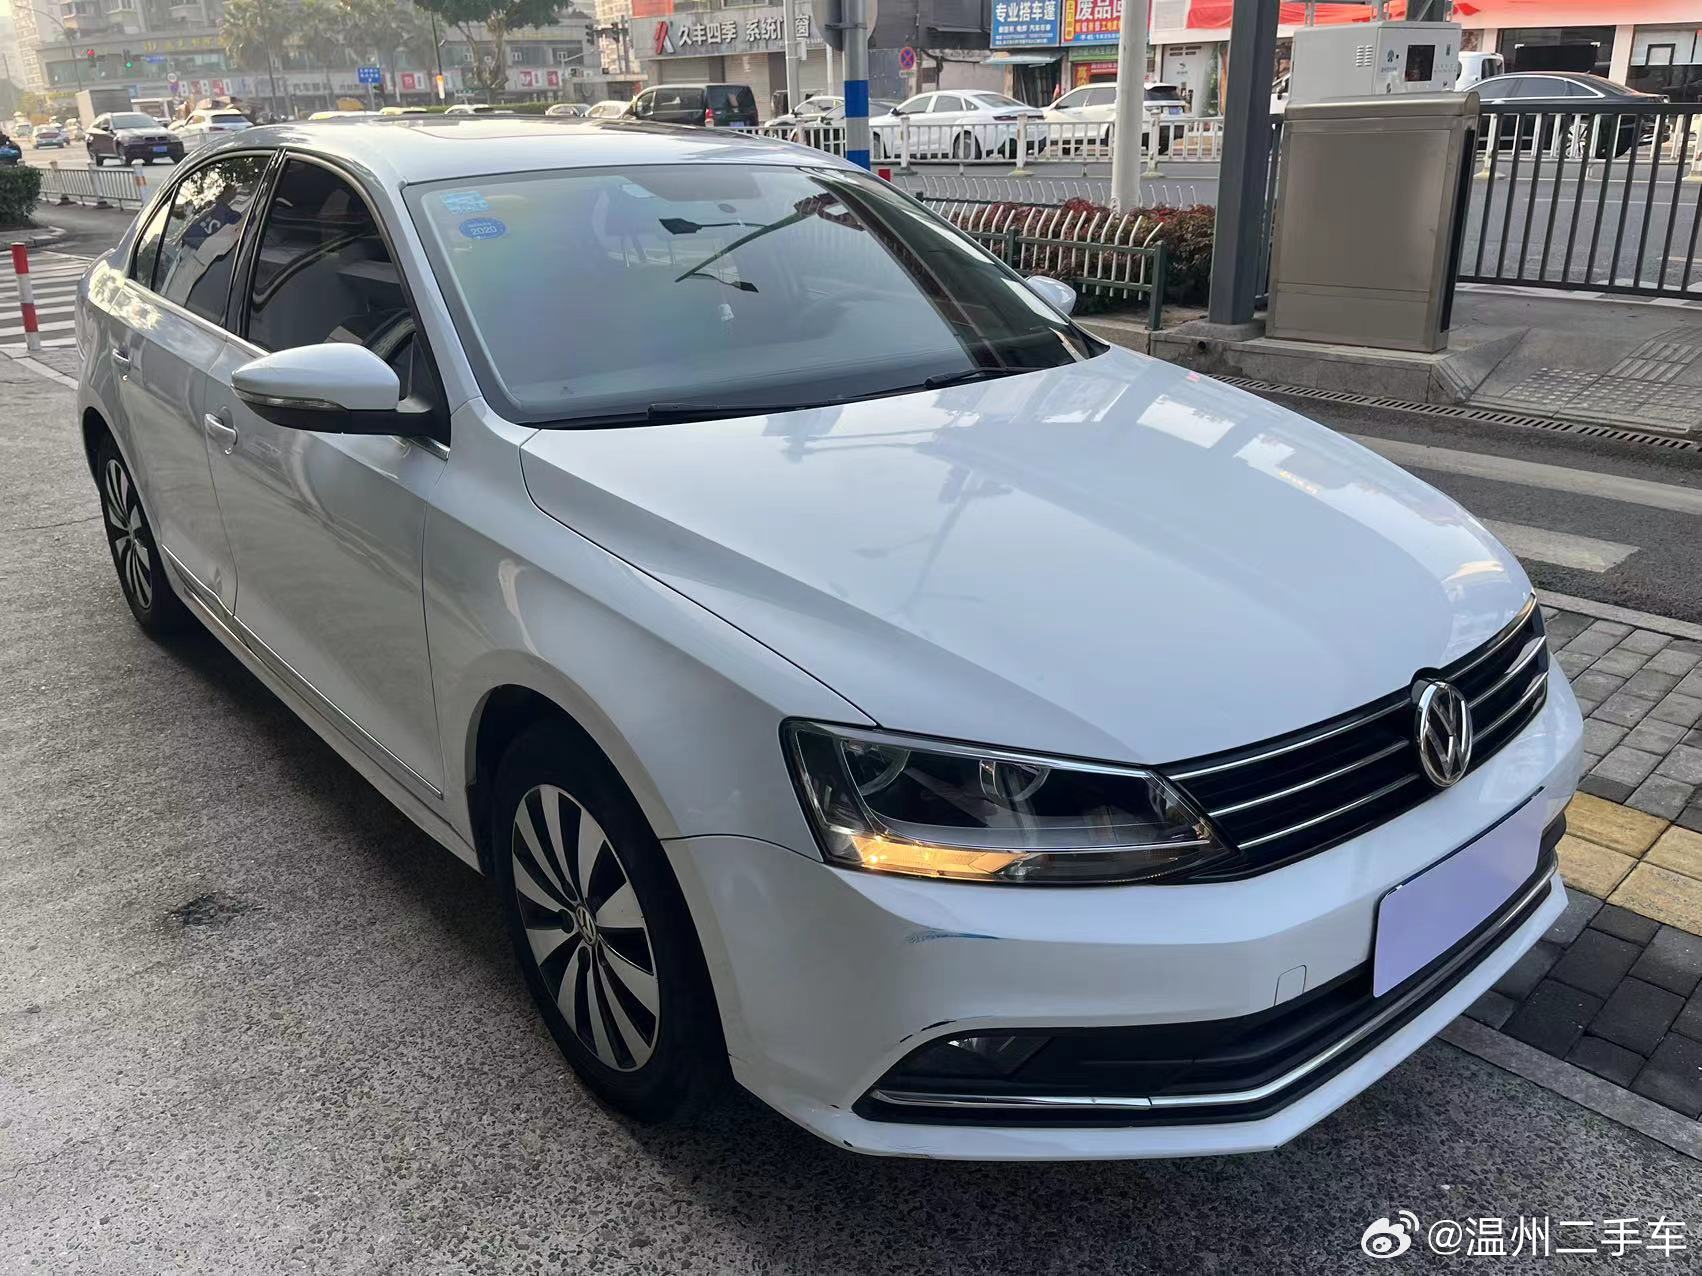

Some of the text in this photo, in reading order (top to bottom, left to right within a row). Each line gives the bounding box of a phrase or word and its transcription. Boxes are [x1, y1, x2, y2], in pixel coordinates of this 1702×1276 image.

[996, 1, 1056, 22] 专业搭车篷
[678, 20, 737, 47] 久丰四季
[471, 226, 497, 235] 2020
